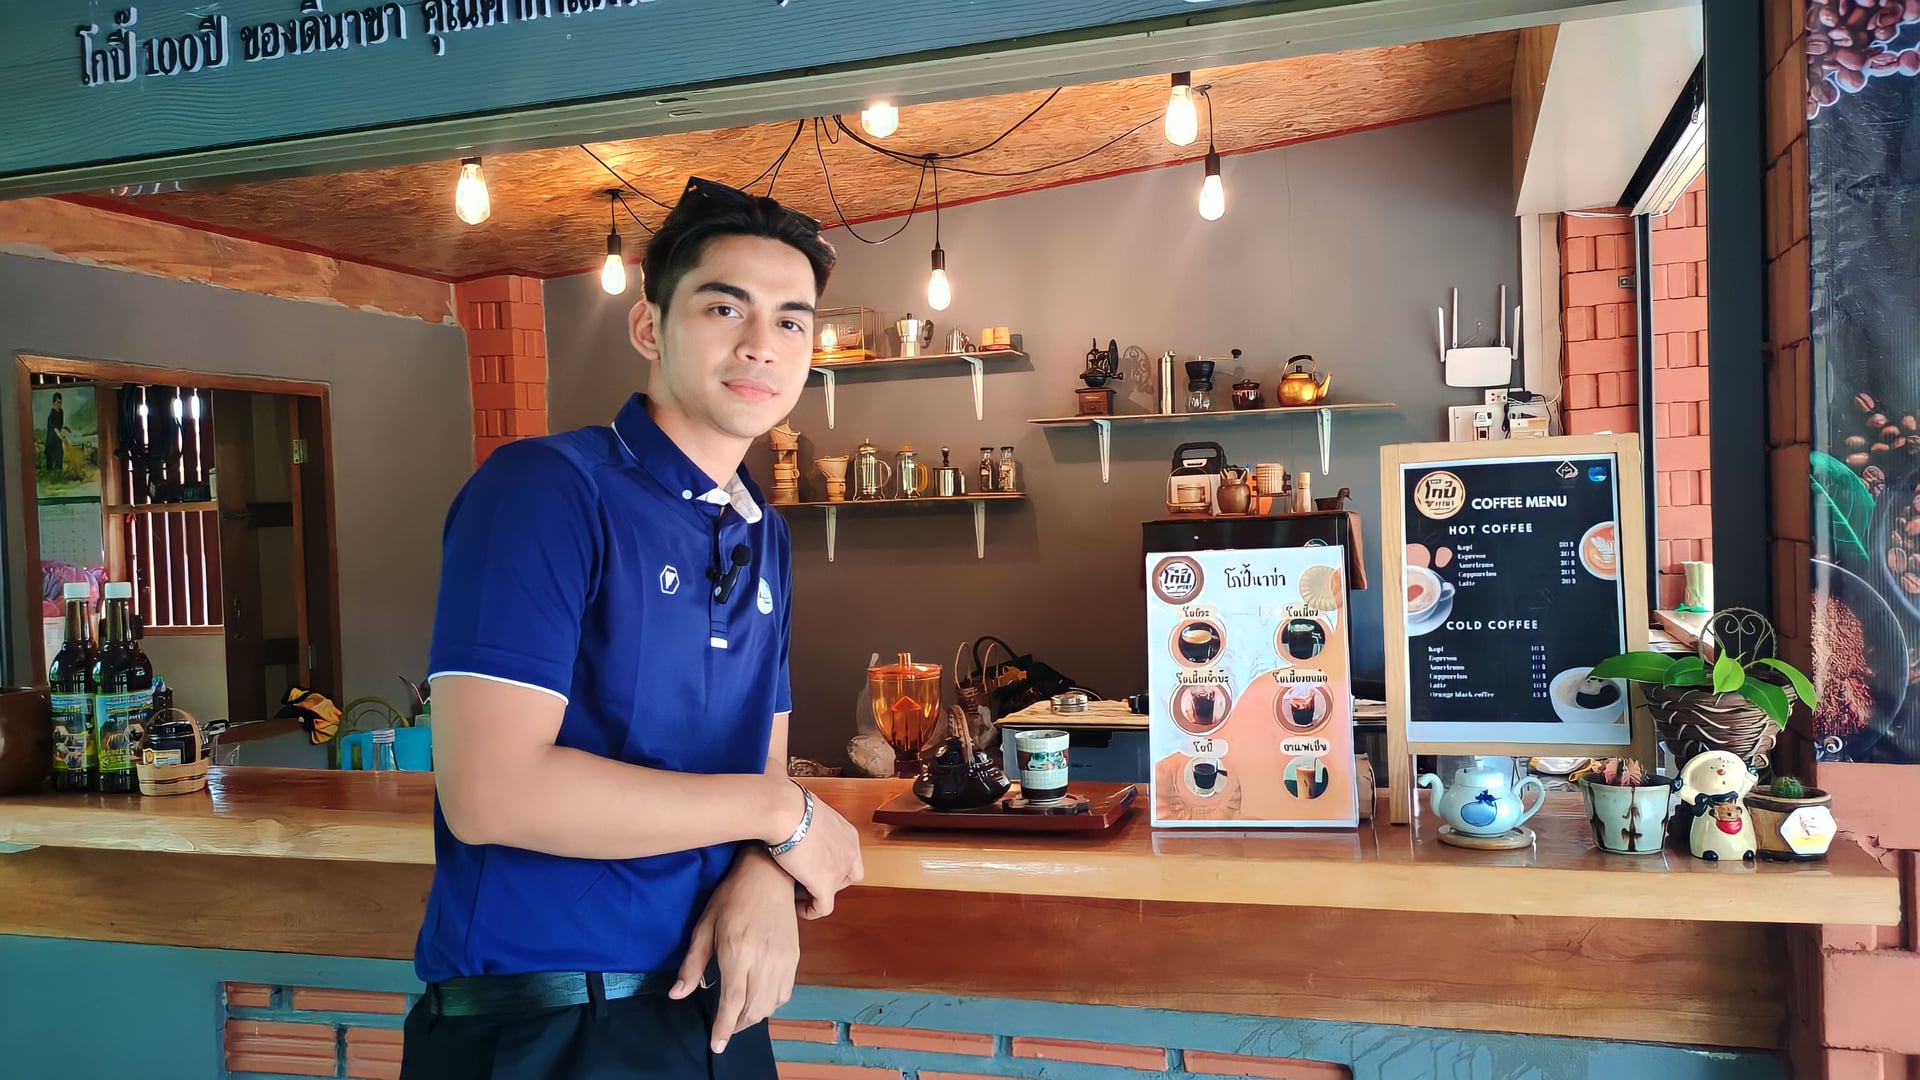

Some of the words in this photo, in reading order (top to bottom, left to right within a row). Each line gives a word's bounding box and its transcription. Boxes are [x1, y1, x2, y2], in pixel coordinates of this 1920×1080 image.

[143, 14, 229, 76] 100ปี
[1471, 496, 1523, 510] COFFEE
[1525, 495, 1568, 508] MENU
[1448, 525, 1476, 535] HOT
[1481, 523, 1533, 534] COFFEE
[1446, 620, 1482, 631] COLD
[1487, 620, 1538, 630] COFFEE
